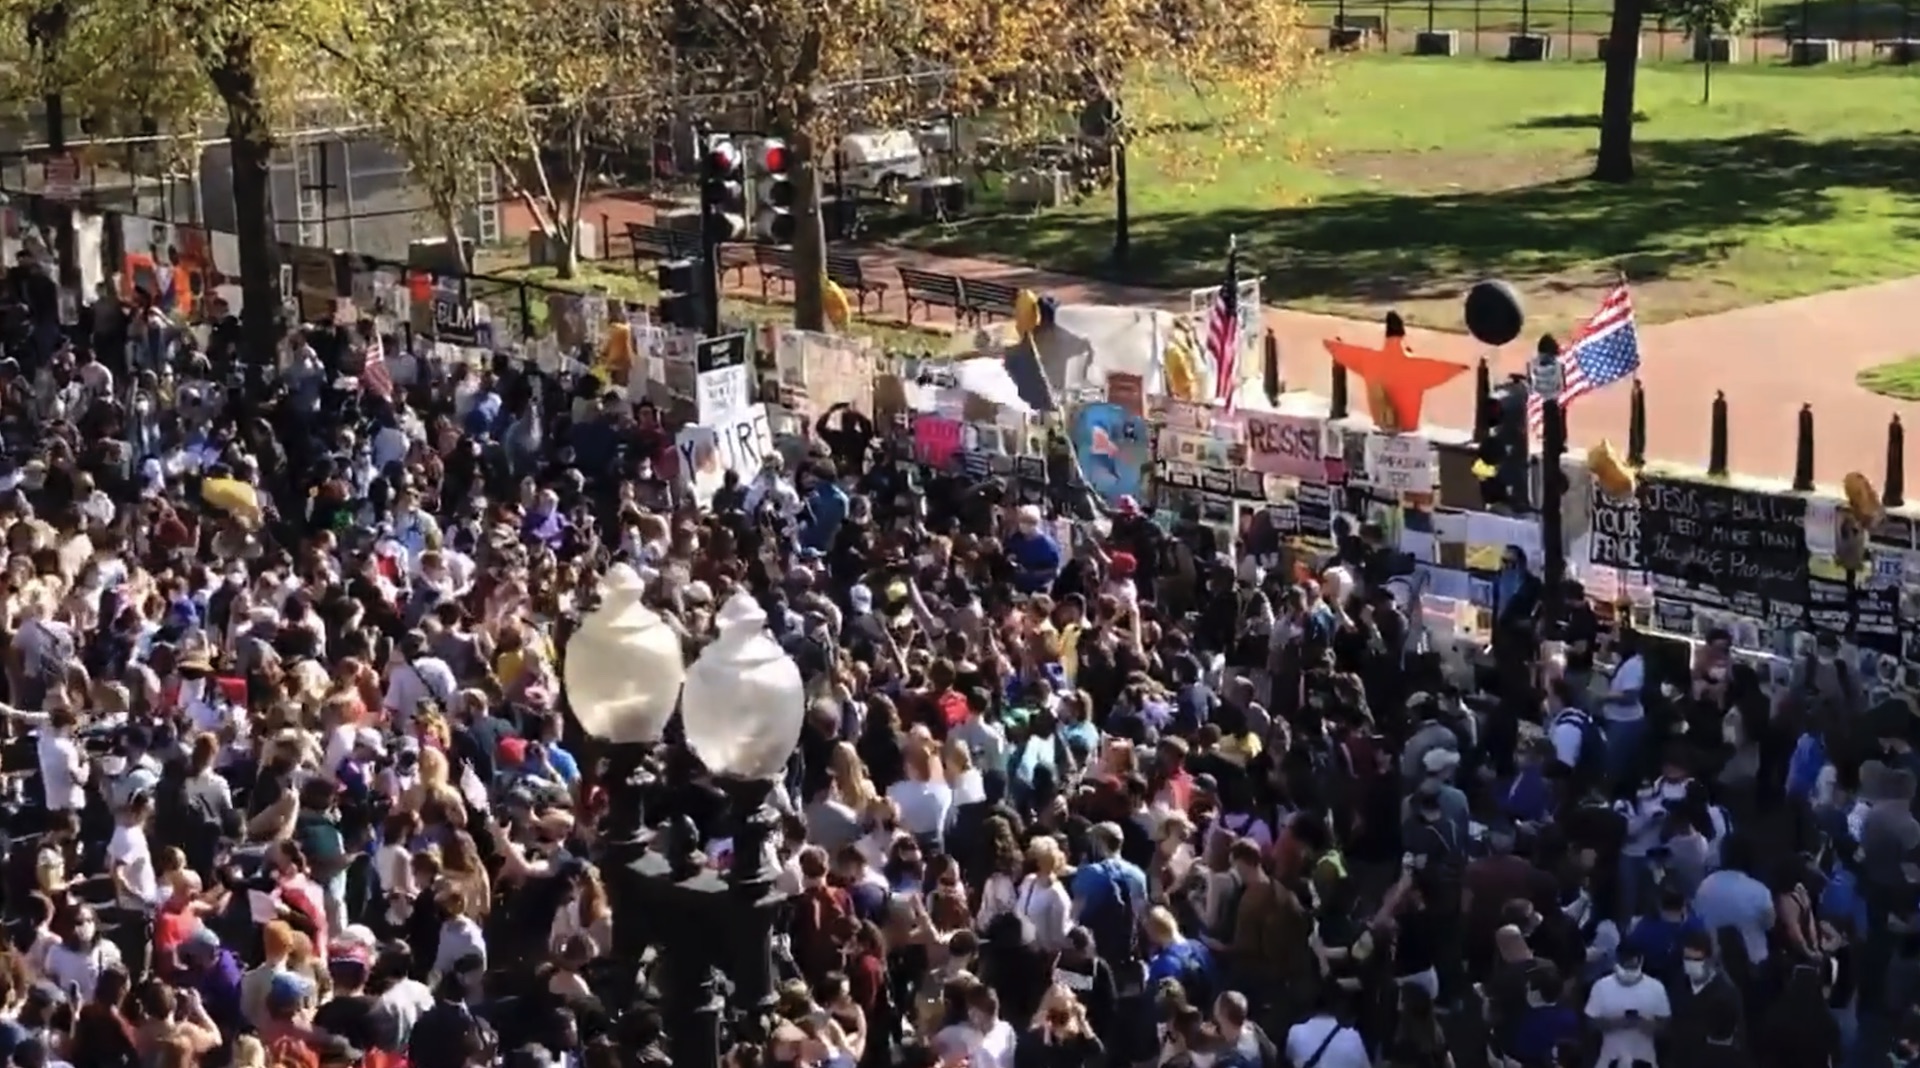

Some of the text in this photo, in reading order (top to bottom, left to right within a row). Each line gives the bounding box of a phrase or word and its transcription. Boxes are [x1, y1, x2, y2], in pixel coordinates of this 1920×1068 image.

[437, 301, 474, 329] BLM
[1248, 418, 1322, 461] RESIST
[1592, 505, 1642, 539] YOUR
[1592, 532, 1642, 567] FENCE
